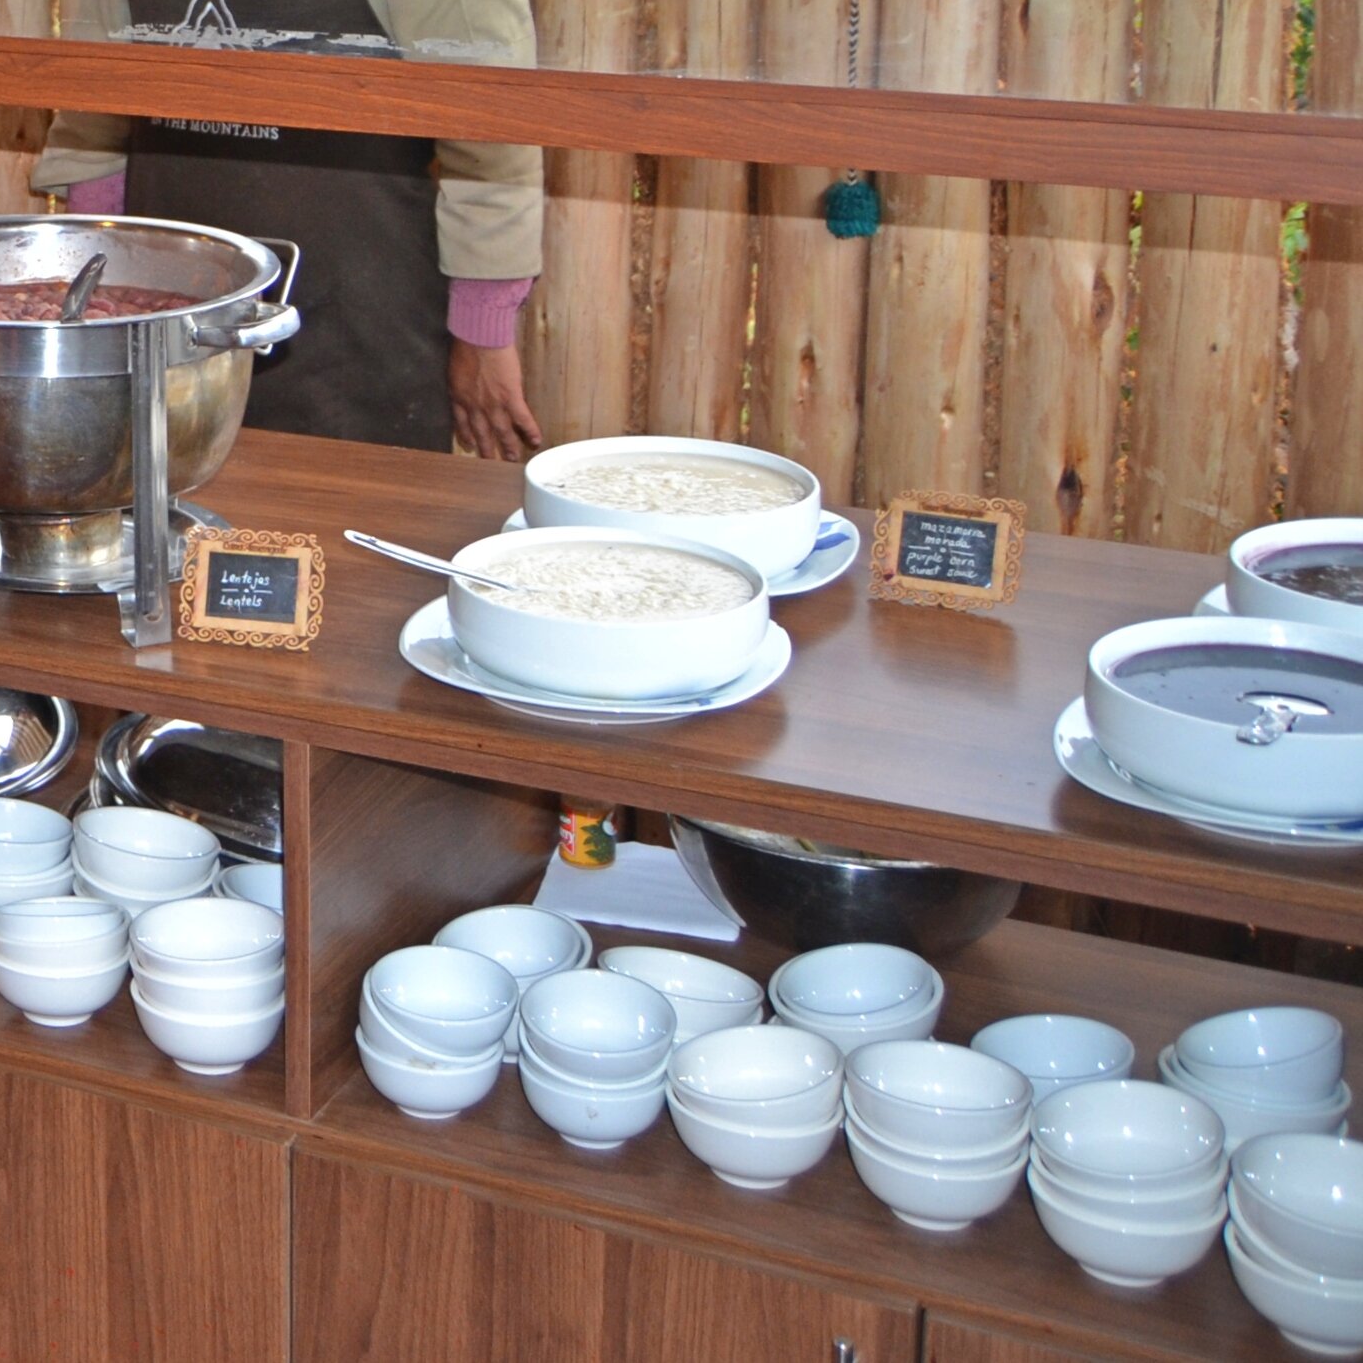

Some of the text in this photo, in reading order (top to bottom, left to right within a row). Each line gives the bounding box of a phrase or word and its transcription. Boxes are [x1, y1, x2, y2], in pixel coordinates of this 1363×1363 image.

[189, 120, 279, 140] MOUNTAINS
[924, 535, 972, 549] morada
[906, 552, 943, 566] purple
[220, 570, 270, 589] Lentejas
